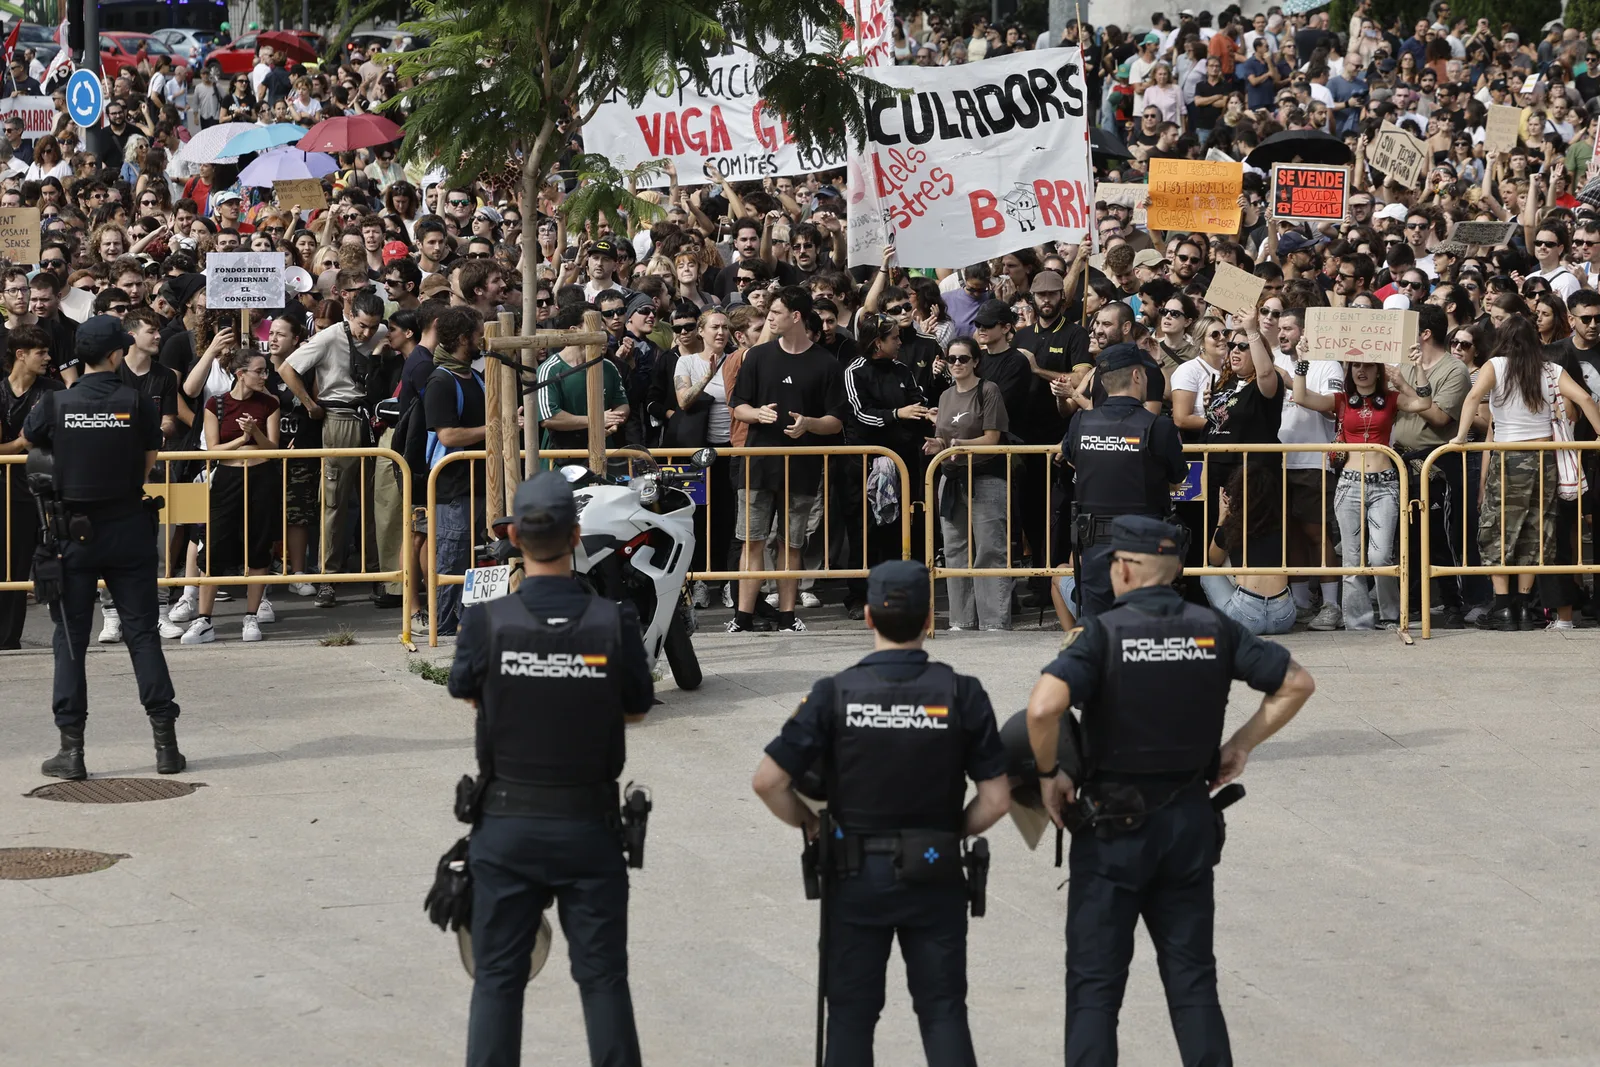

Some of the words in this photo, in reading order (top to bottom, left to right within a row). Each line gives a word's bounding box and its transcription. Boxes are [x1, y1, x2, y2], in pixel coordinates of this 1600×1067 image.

[865, 62, 1083, 146] CULADORS
[636, 104, 733, 157] VAGA
[1381, 135, 1396, 154] SIN
[1278, 170, 1295, 186] SE
[1298, 171, 1344, 188] VENDE
[1156, 181, 1236, 195] DESTERRANDO
[1293, 189, 1308, 200] TU
[1310, 190, 1338, 201] VIDA
[1156, 198, 1169, 208] DE
[1157, 209, 1197, 228] CASA
[4, 239, 31, 248] SENSE
[1361, 326, 1392, 334] CASES
[1314, 336, 1356, 349] SENSE
[1361, 340, 1401, 352] GENT
[1081, 435, 1127, 443] POLICIA
[1080, 443, 1139, 451] NACIONAL
[475, 568, 507, 584] 2862
[473, 584, 497, 599] LNP
[1122, 637, 1198, 650] POLICIA
[501, 651, 586, 666] POLICIA
[1123, 648, 1216, 662] NACIONAL
[501, 663, 607, 678] NACIONAL
[846, 703, 928, 717] POLICIA
[846, 715, 948, 729] NACIONAL
